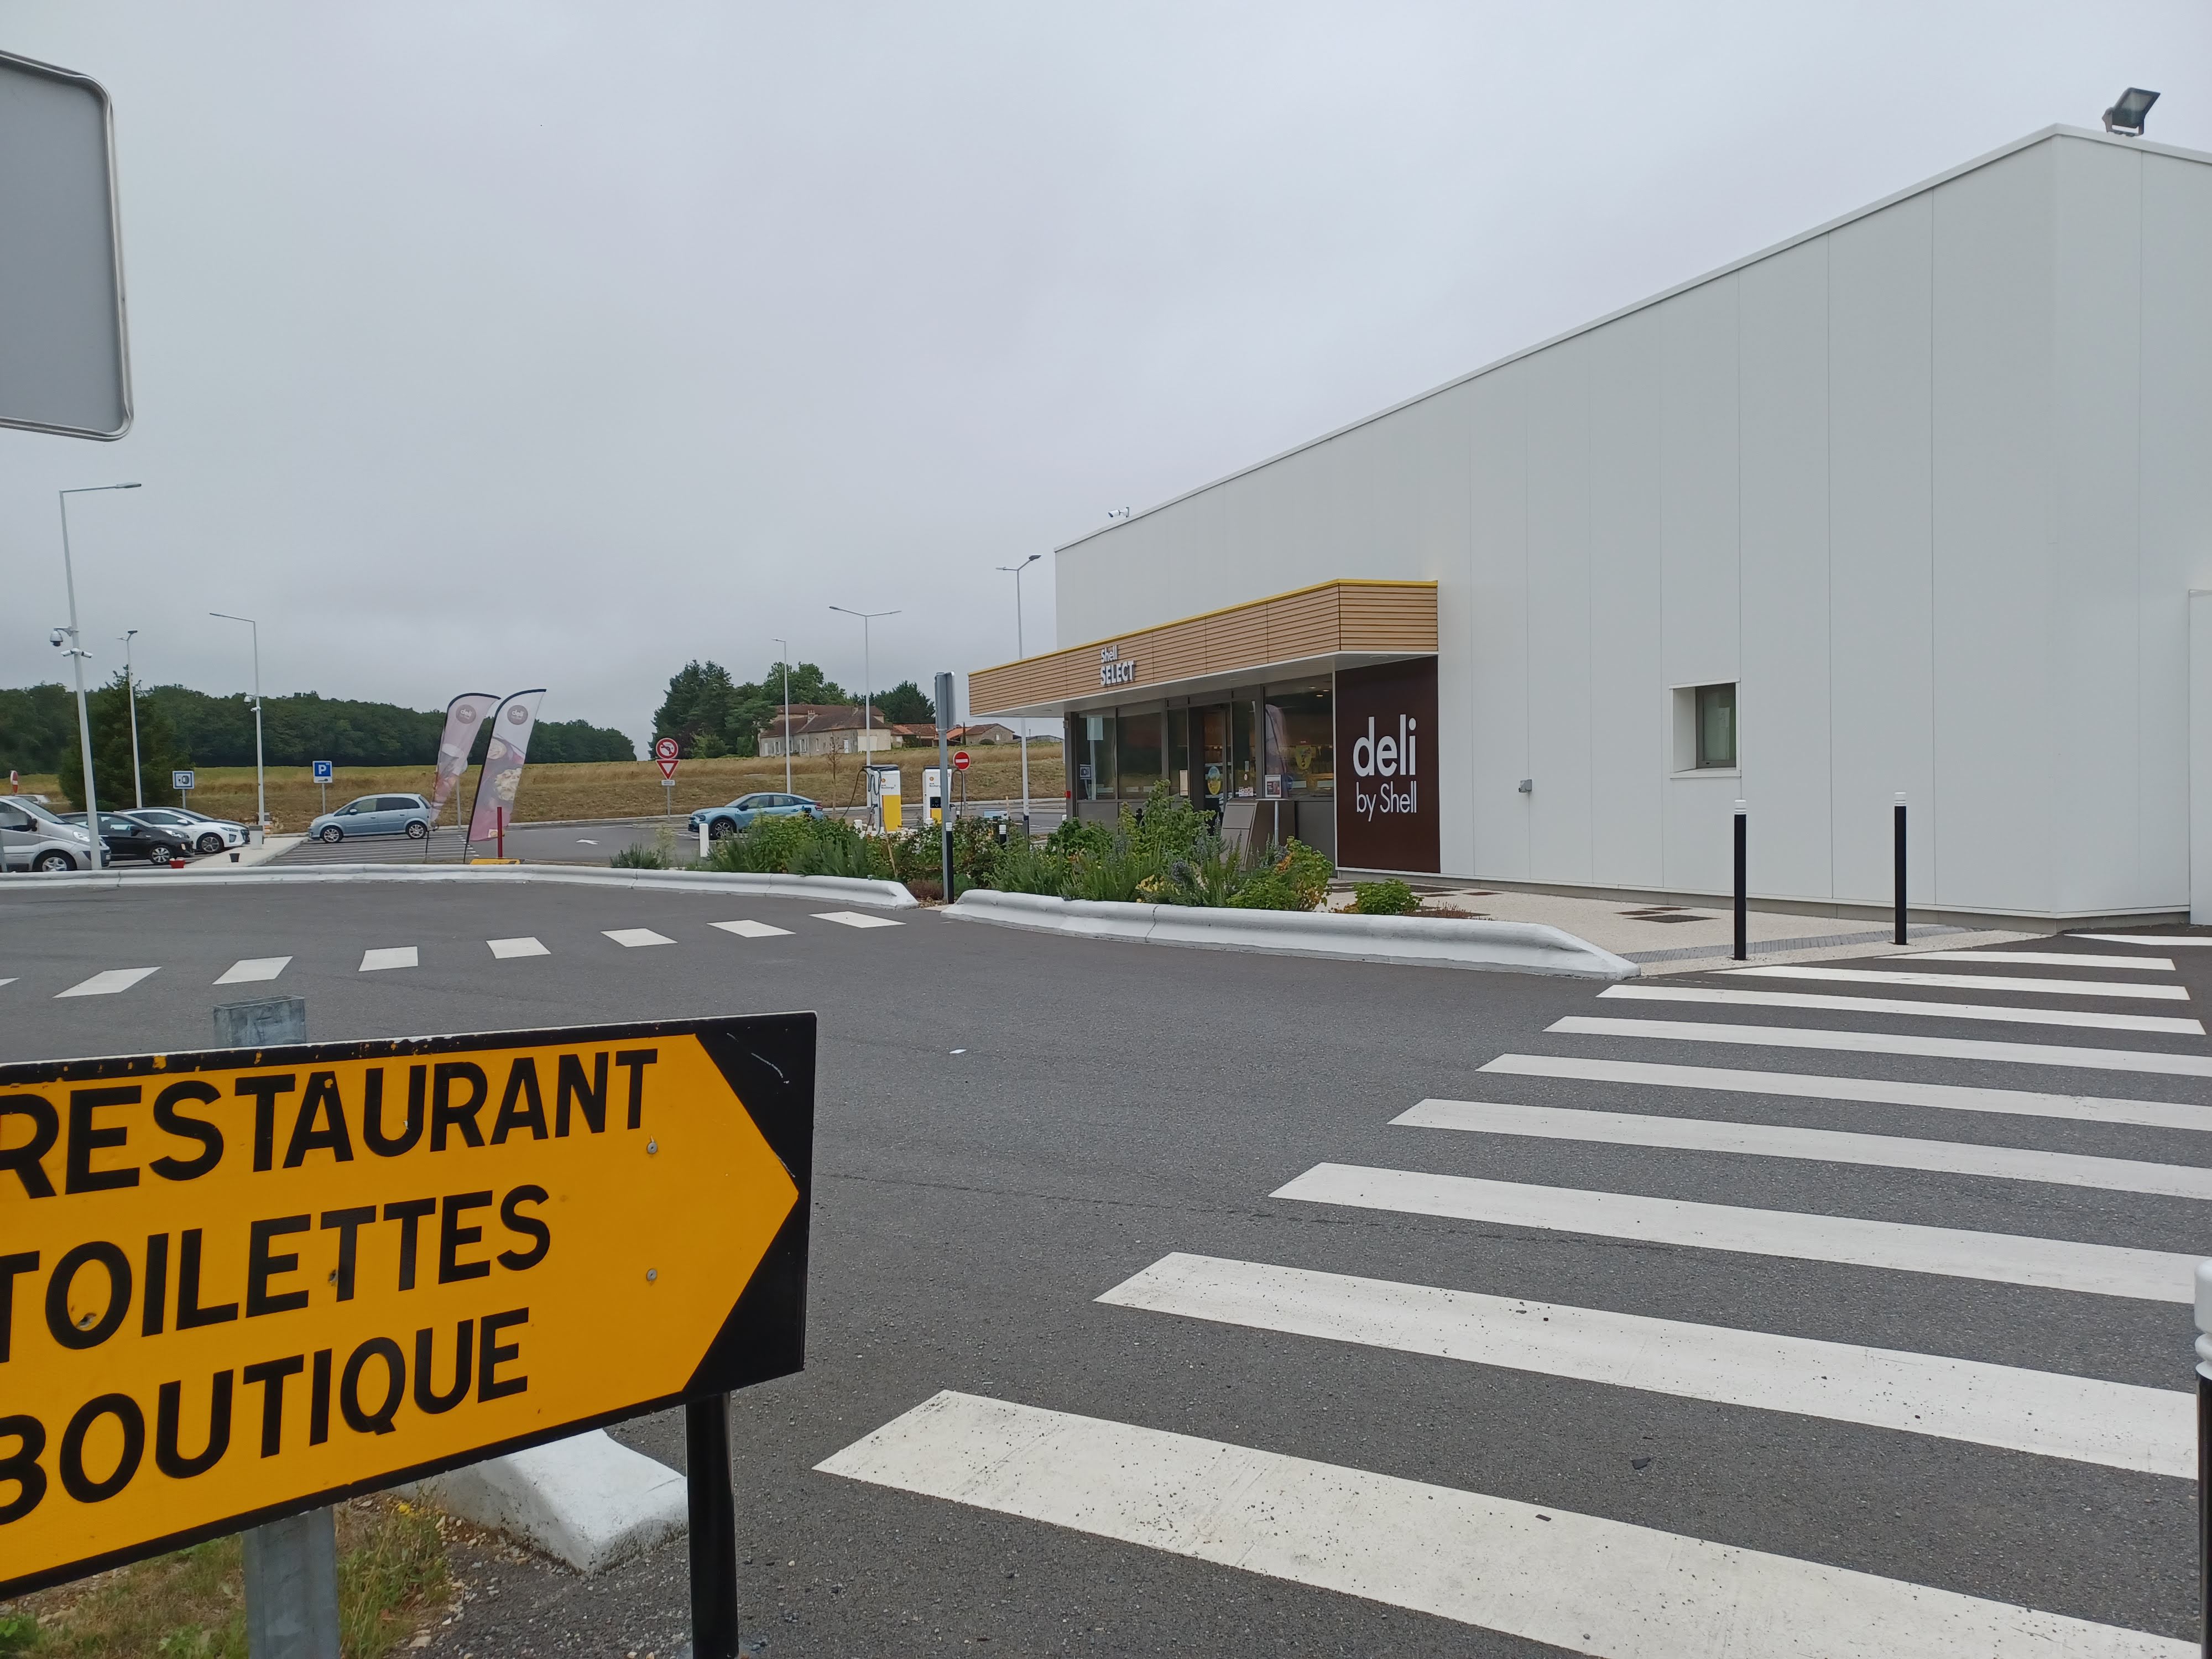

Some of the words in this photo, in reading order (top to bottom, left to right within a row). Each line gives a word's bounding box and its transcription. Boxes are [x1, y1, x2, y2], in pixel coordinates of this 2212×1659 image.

[1100, 645, 1118, 663] Shell
[1100, 660, 1135, 685] SELECT
[460, 708, 472, 717] deli
[1353, 714, 1416, 777] deli
[318, 764, 327, 775] P
[1357, 781, 1376, 822] by
[1380, 780, 1417, 813] Shell
[0, 1048, 658, 1198] RESTAURANT
[0, 1184, 550, 1363] TOILETTES
[0, 1307, 529, 1525] BOUTIQUE
